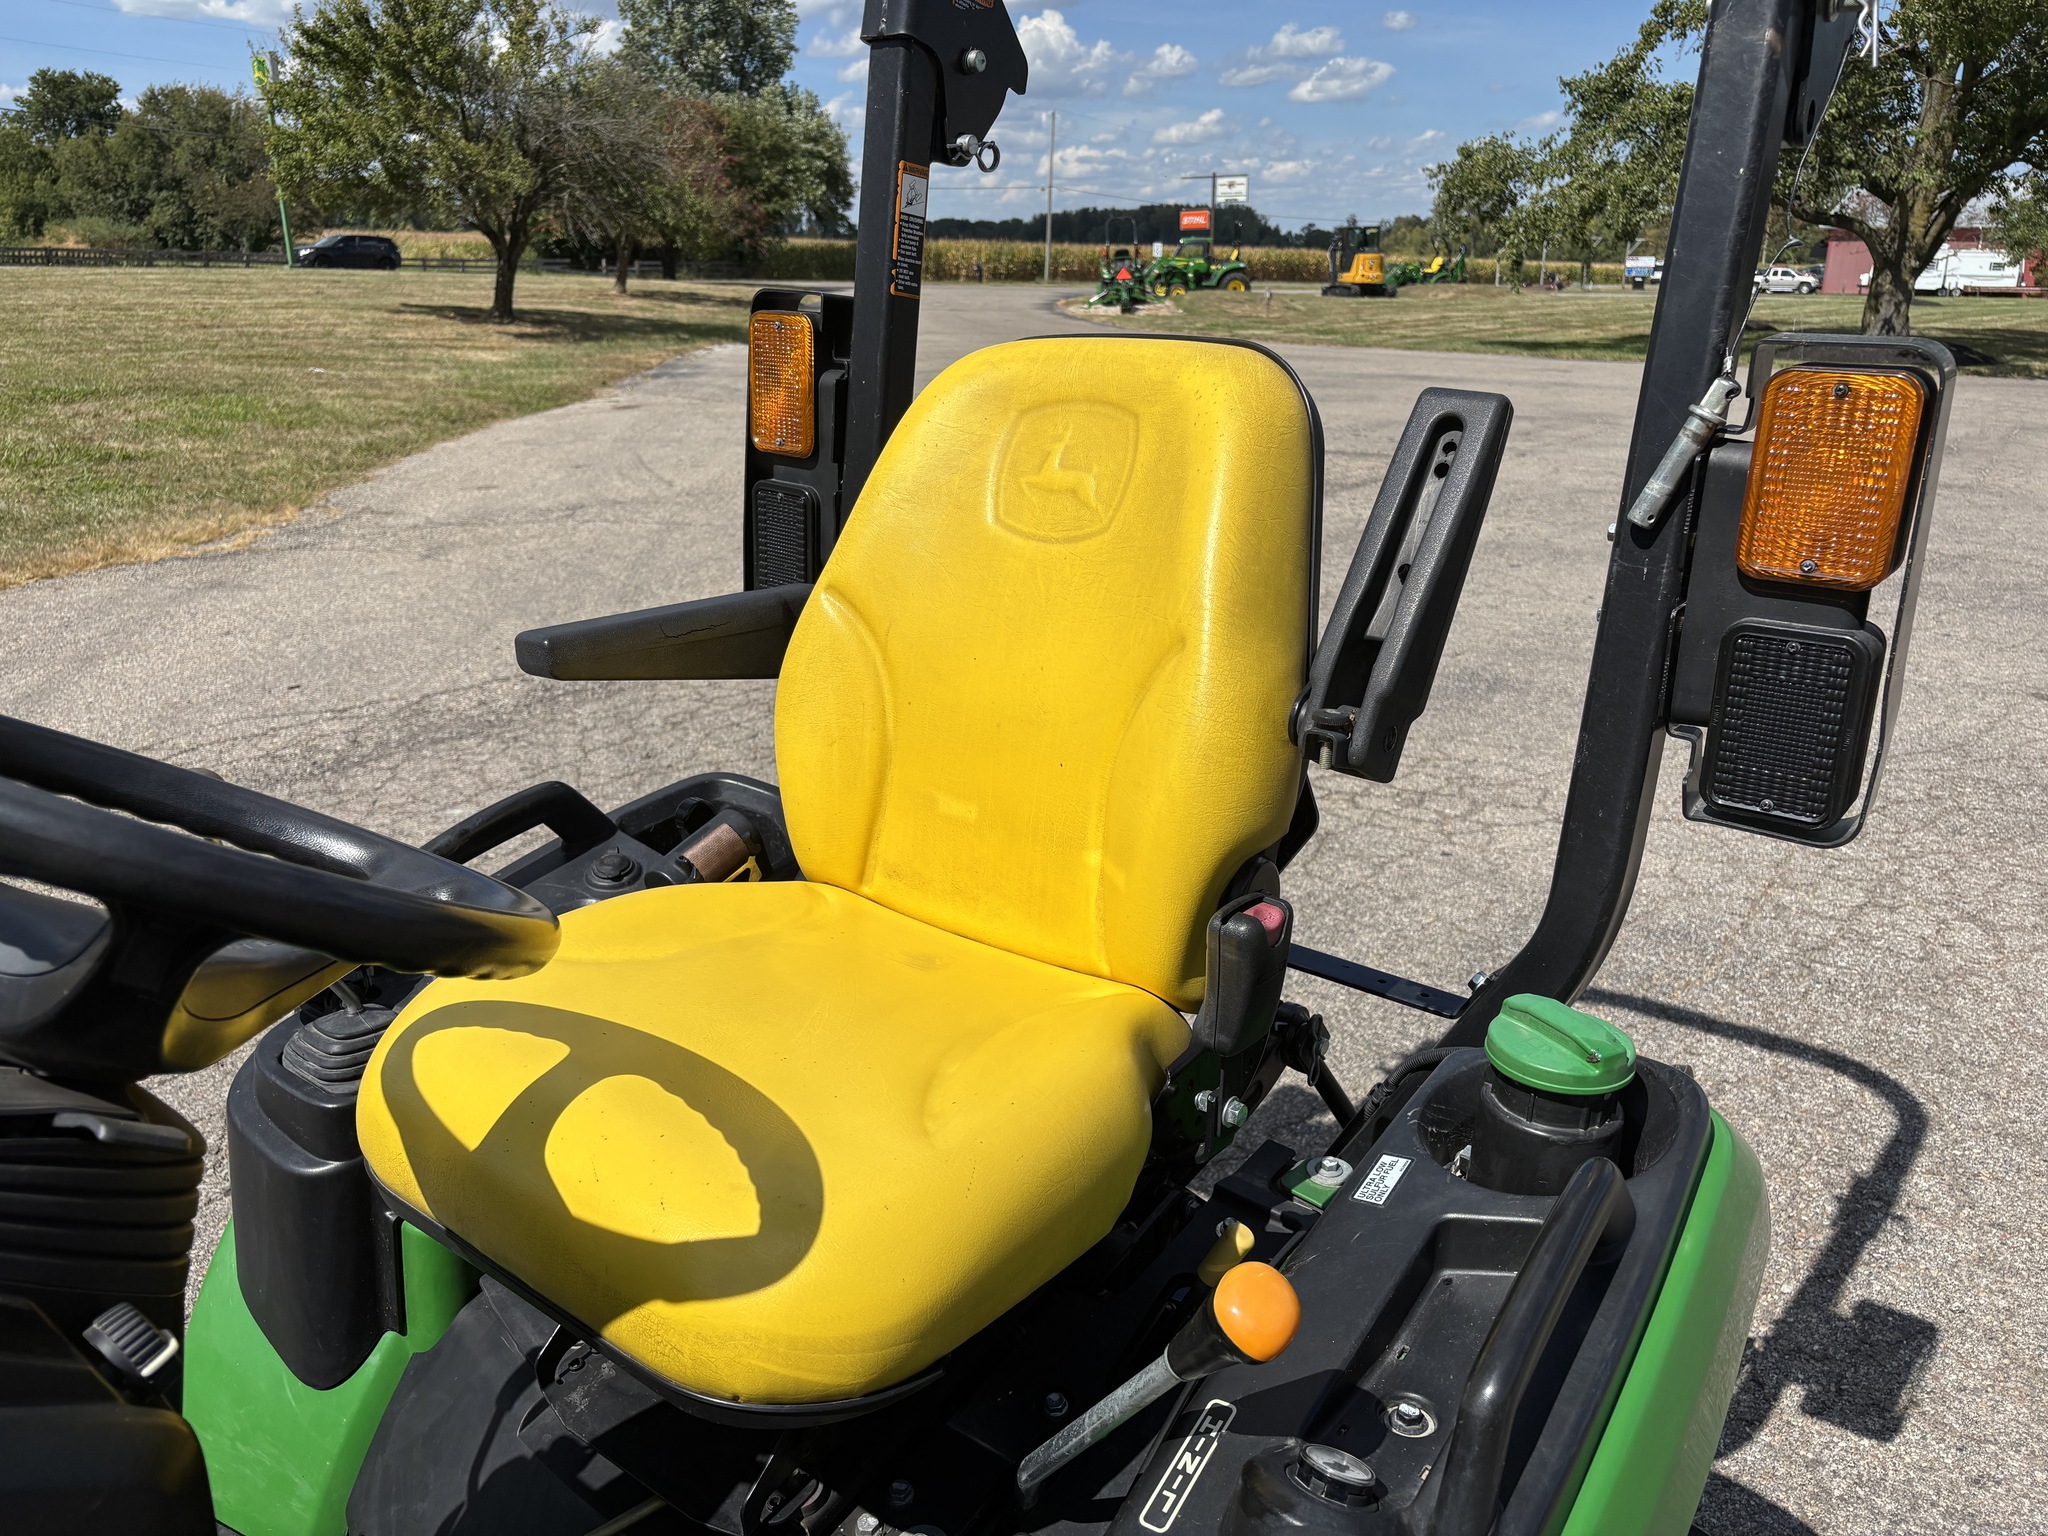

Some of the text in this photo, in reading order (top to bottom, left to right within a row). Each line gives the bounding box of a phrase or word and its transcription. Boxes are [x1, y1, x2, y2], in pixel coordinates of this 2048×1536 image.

[1182, 215, 1206, 224] STIHL
[1358, 1161, 1388, 1198] ULTRA LOW
[1366, 1159, 1400, 1200] SULFUR FUEL
[1374, 1184, 1390, 1202] ONLY
